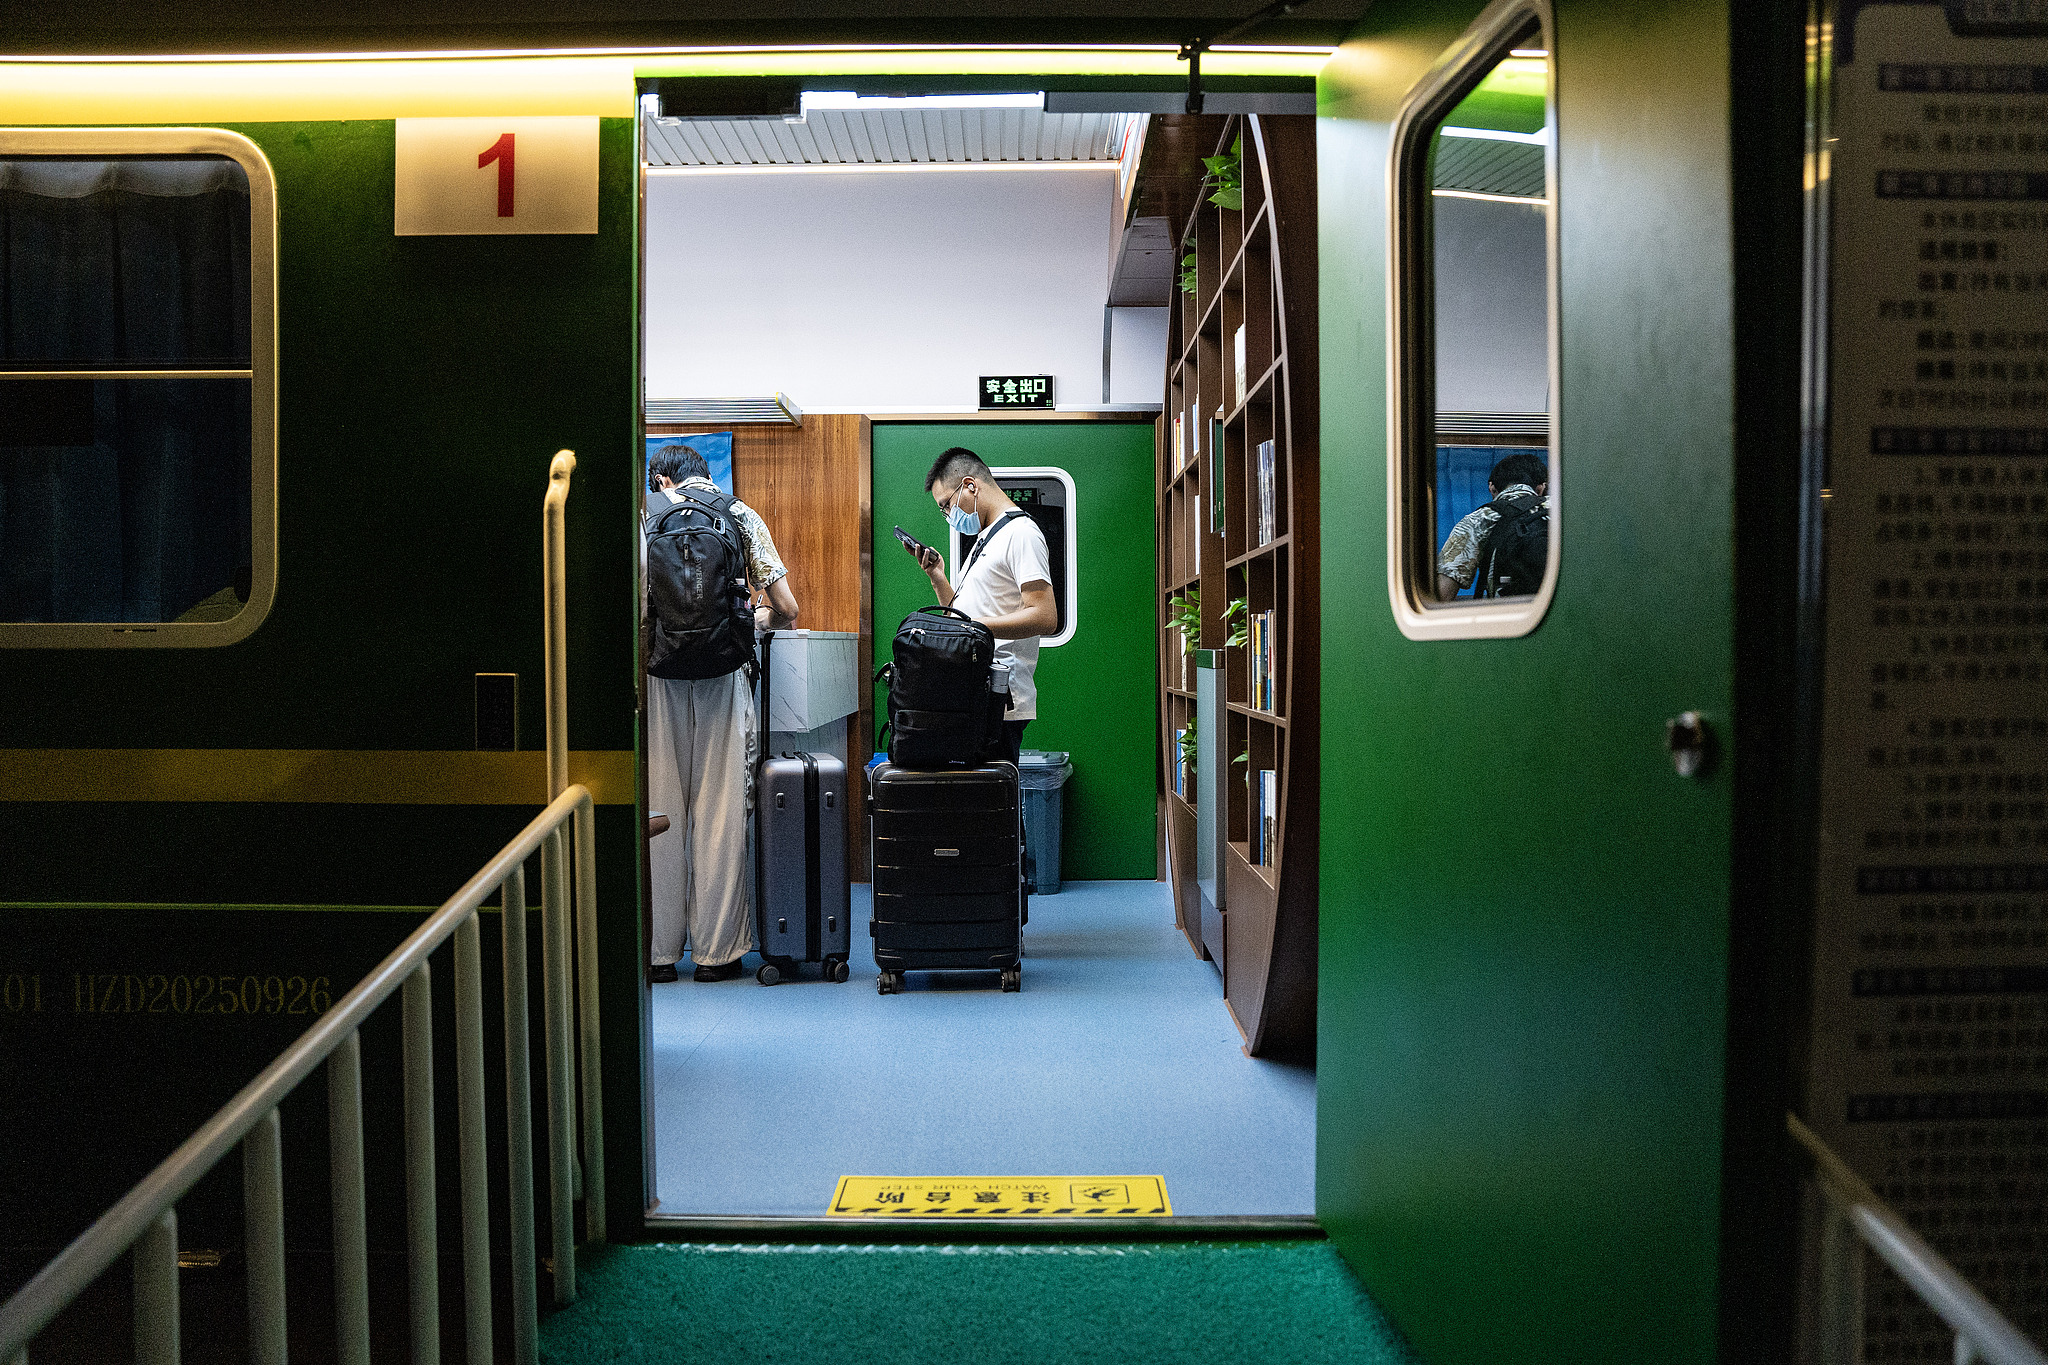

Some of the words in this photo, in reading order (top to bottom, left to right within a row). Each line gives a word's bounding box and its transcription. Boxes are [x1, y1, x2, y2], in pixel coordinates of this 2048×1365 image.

[479, 133, 515, 217] 1
[986, 378, 1046, 394] 安全出口
[993, 394, 1039, 403] EXIT
[696, 563, 704, 599] WENGER
[73, 974, 332, 1015] HZD20250926
[875, 1192, 1051, 1204] 注意台阶
